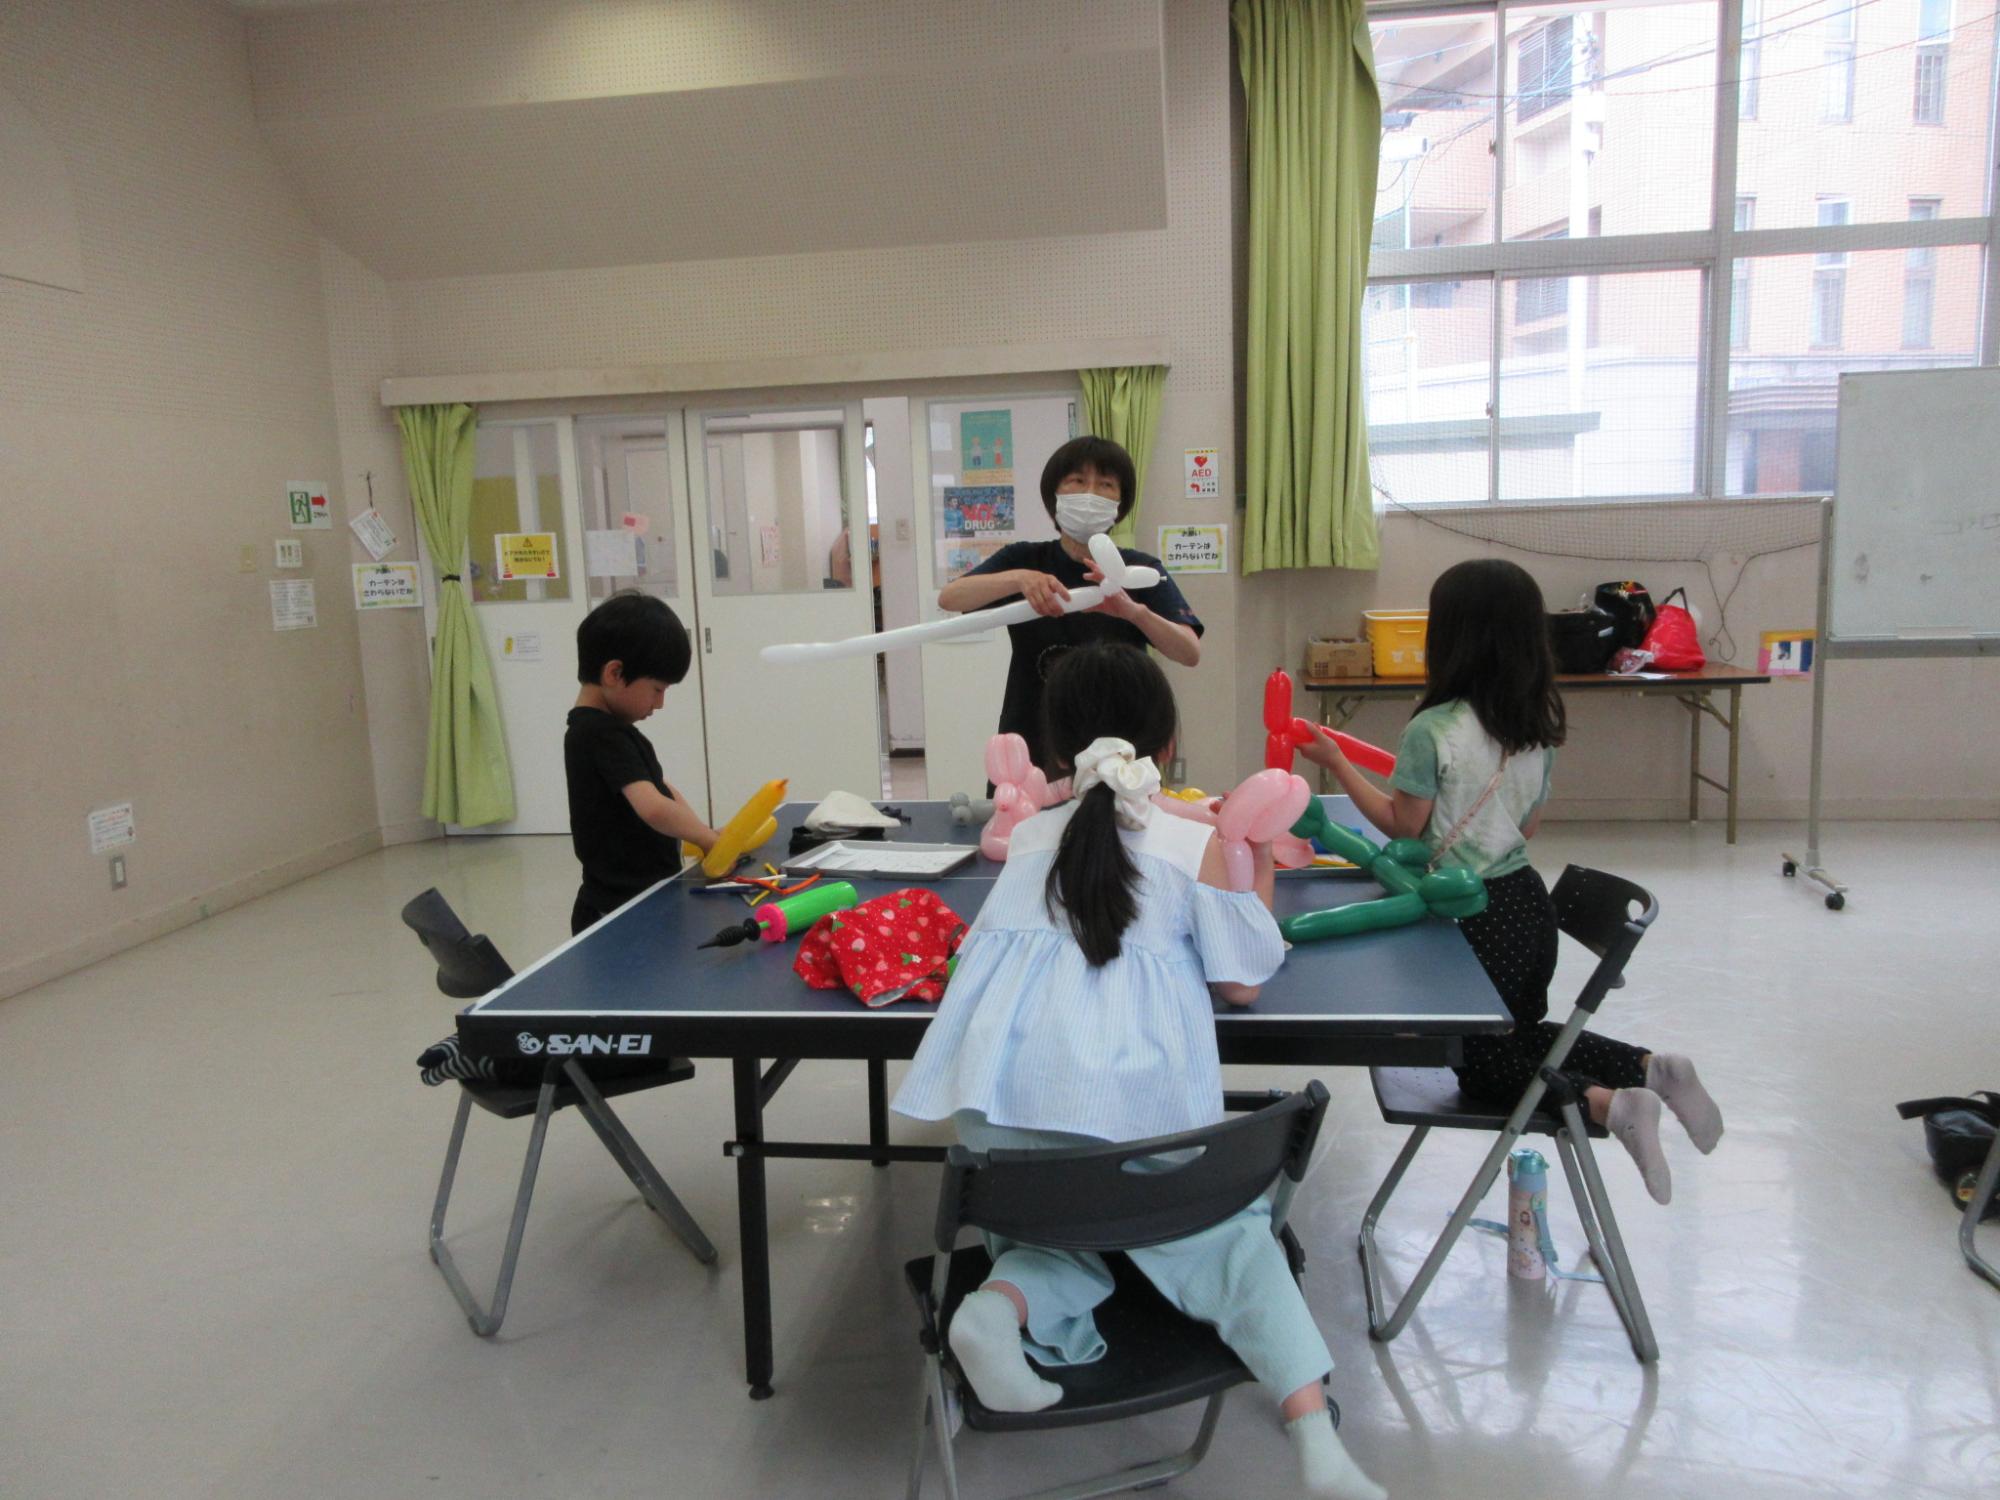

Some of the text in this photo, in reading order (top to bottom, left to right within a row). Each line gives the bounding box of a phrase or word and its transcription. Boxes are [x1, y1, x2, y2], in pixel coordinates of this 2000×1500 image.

[1191, 468, 1212, 478] AED
[964, 519, 995, 530] DRUG
[1174, 542, 1211, 550] カーテンは
[547, 1034, 653, 1054] SAN-EI
